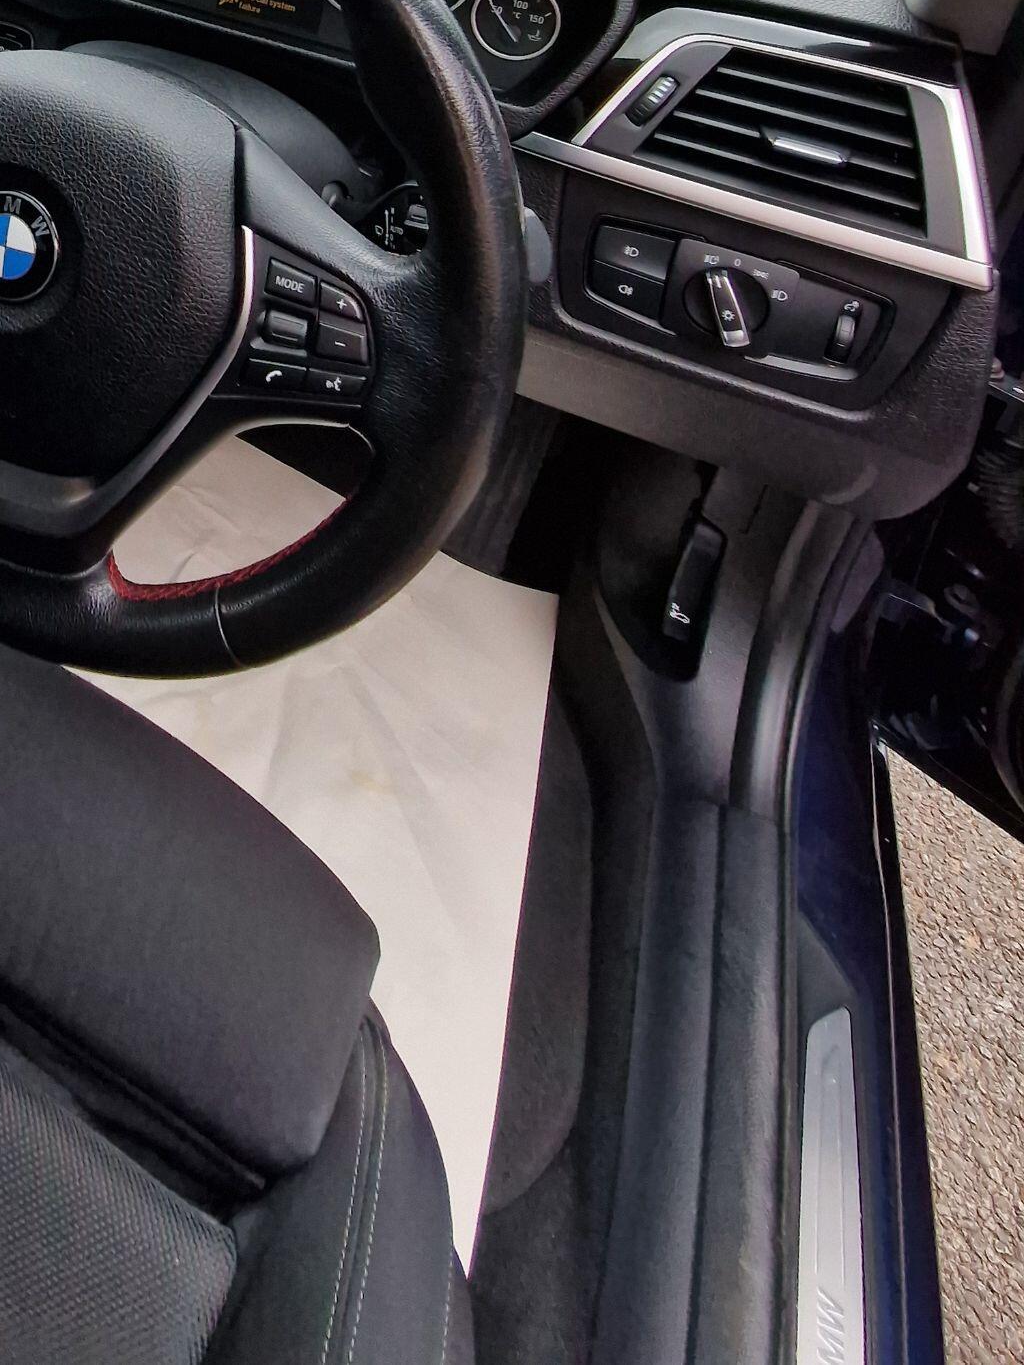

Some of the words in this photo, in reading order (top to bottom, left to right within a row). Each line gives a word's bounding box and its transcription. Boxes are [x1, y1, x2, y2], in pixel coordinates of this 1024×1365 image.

[239, 1, 260, 13] failure
[269, 0, 296, 12] system
[513, 0, 528, 10] 100
[529, 14, 544, 24] 150
[390, 225, 404, 235] AUTO
[276, 275, 305, 293] MODE
